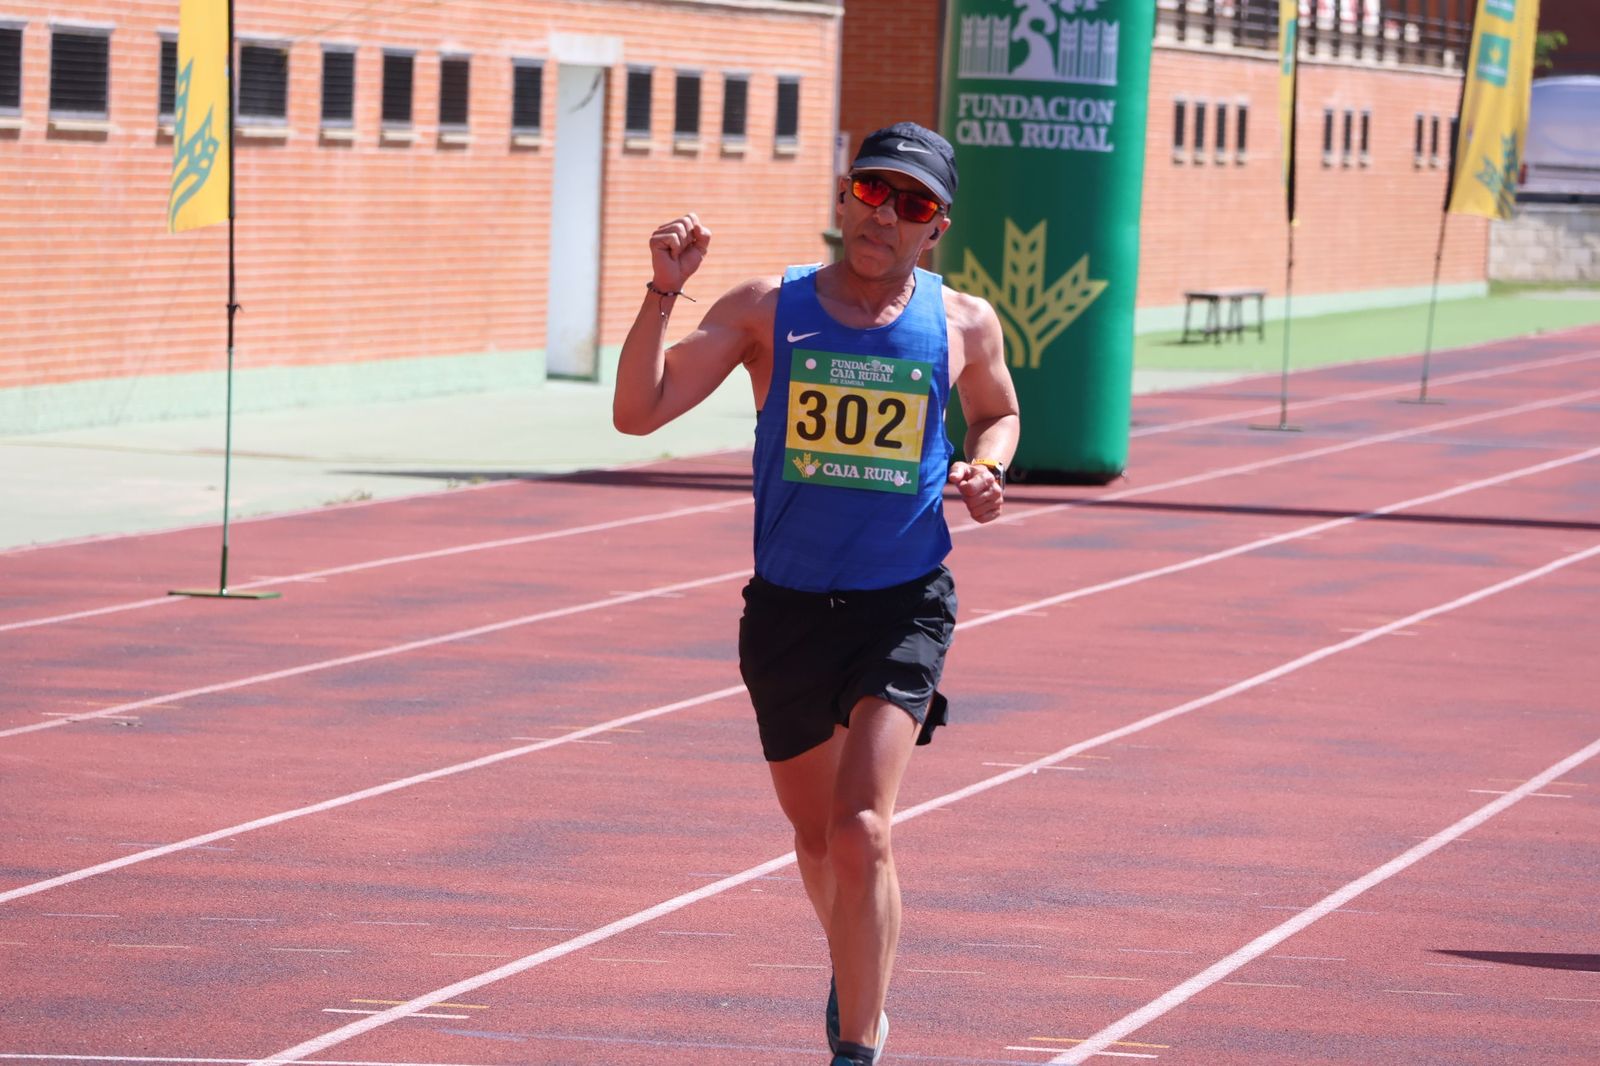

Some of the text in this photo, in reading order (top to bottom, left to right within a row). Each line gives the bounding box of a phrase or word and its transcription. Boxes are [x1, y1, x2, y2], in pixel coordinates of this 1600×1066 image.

[958, 93, 1116, 125] FUNDACION
[956, 120, 1114, 152] CAJA RURAL
[830, 368, 893, 383] CAJA RURAL
[831, 359, 895, 374] FUNDACON
[796, 390, 906, 449] 302
[822, 463, 860, 478] CAJA
